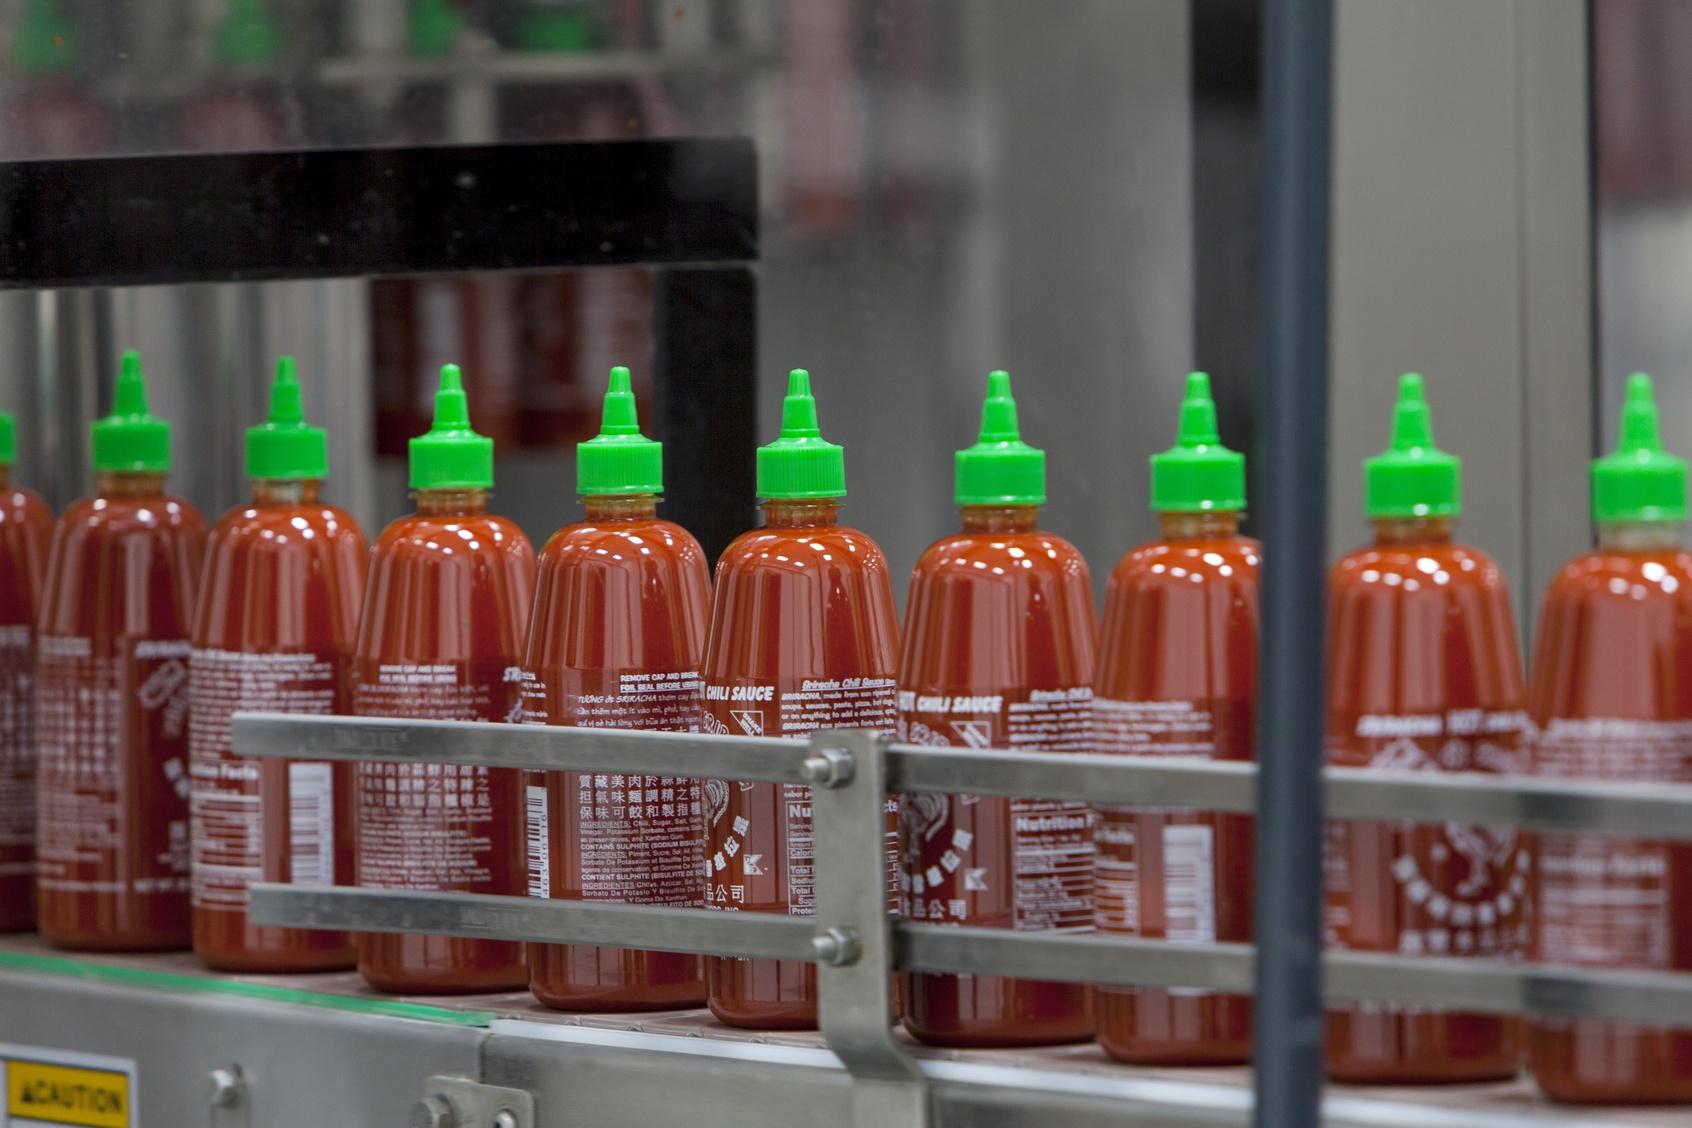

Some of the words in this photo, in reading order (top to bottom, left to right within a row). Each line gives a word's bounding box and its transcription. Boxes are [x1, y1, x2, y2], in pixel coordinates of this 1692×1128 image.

[620, 674, 650, 682] REMOVE
[651, 673, 665, 681] CAP
[666, 672, 680, 680] AND
[637, 683, 655, 691] SEAL
[656, 682, 681, 690] BEFORE
[706, 685, 730, 700] CHILI
[731, 686, 775, 701] SAUCE
[616, 694, 657, 703] SRIRACHA
[616, 842, 650, 850] SULPHITE
[790, 849, 815, 857] Calori
[791, 866, 811, 874] Total
[616, 872, 650, 880] SULPHITE
[791, 887, 811, 895] Total
[33, 1078, 122, 1116] CAUTION
